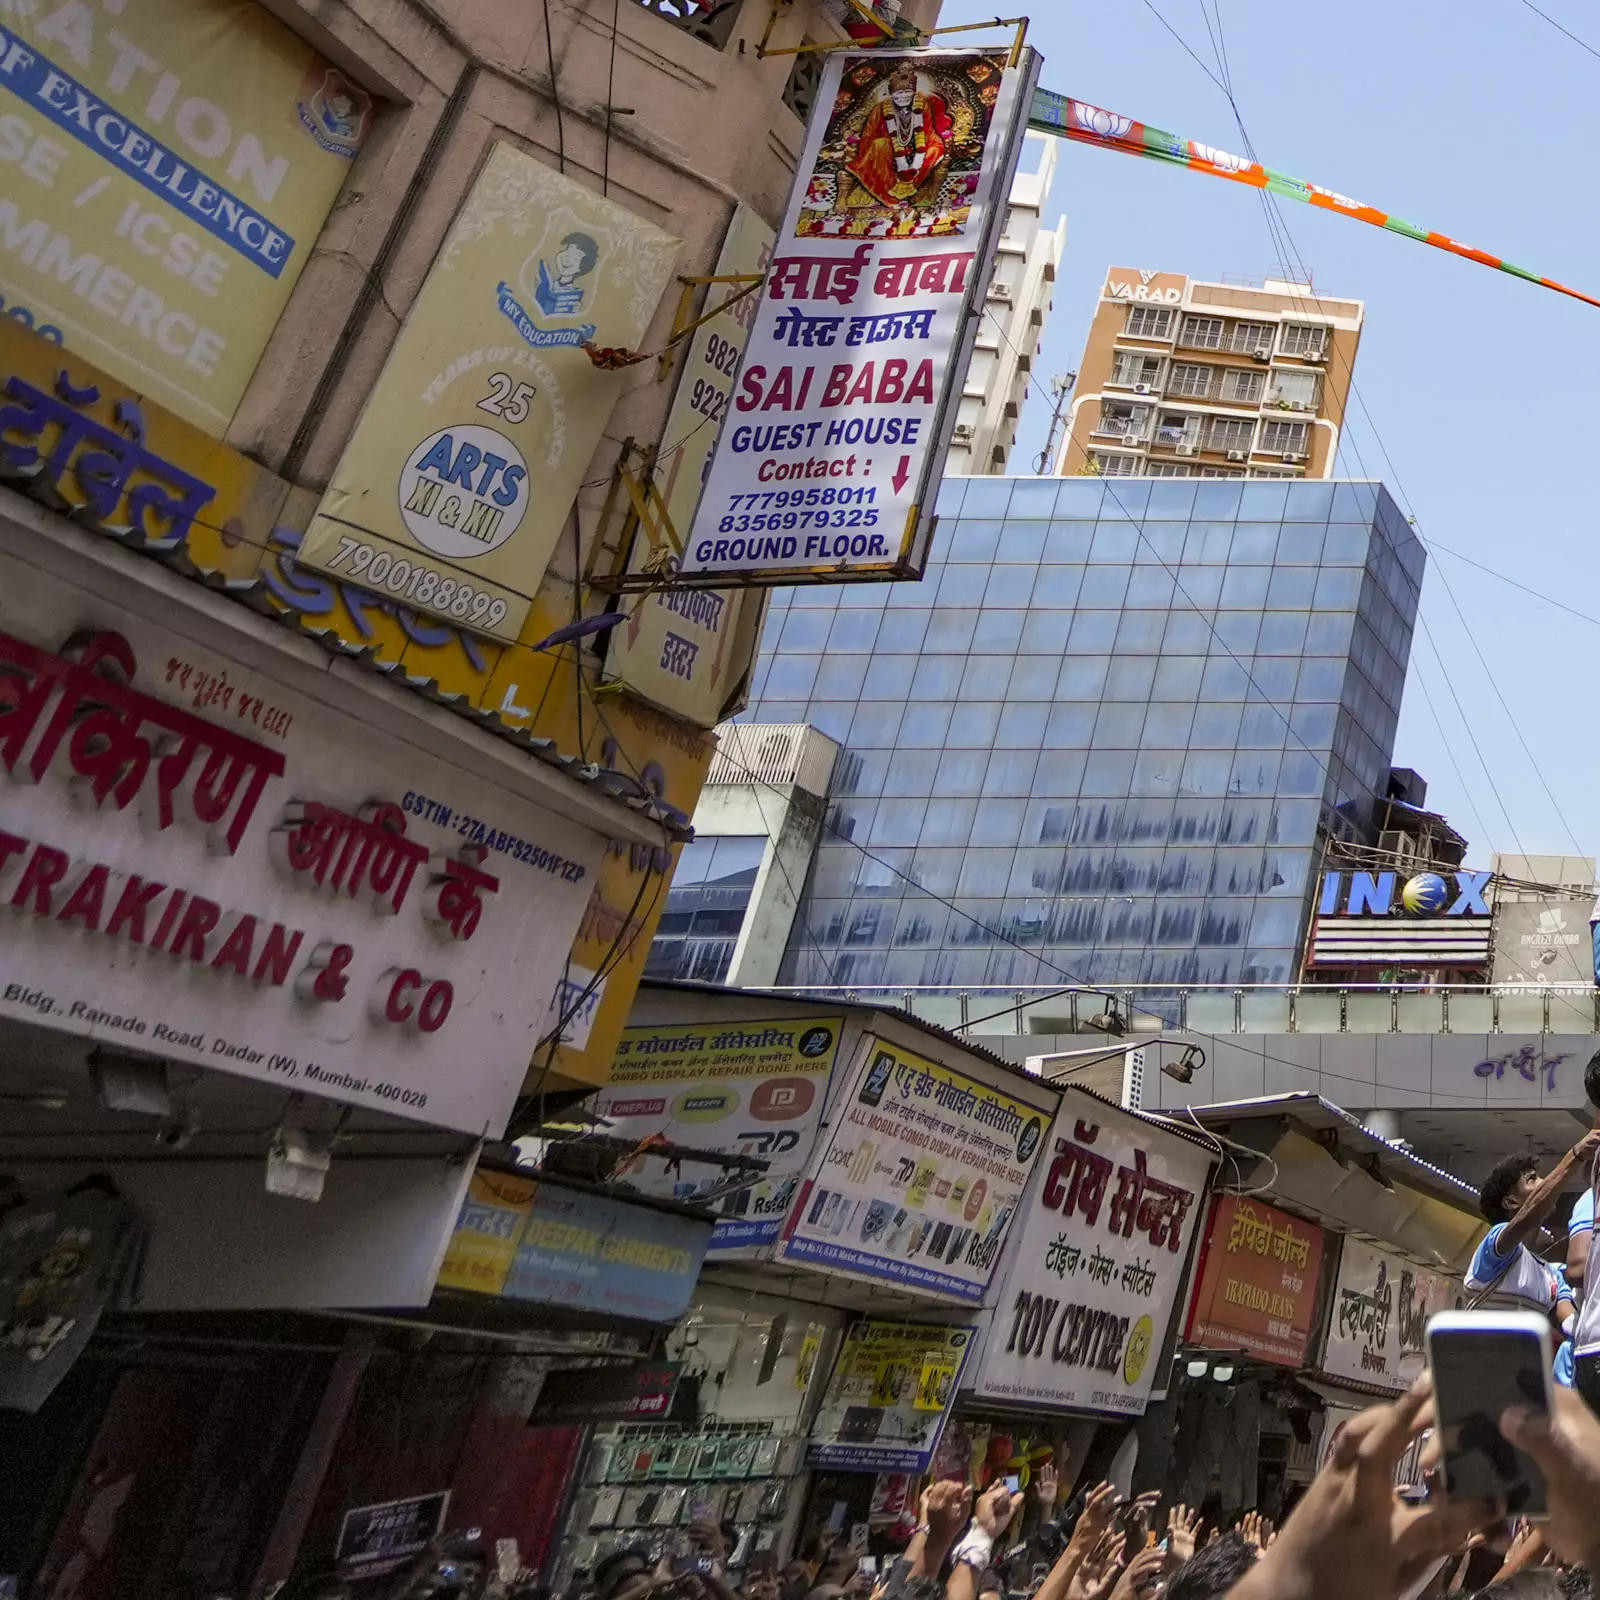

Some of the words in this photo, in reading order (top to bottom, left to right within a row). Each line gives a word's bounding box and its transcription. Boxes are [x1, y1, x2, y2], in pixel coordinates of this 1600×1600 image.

[36, 68, 288, 265] EXCELLENCE
[114, 199, 231, 298] ICSE
[768, 243, 875, 305] साई
[875, 251, 976, 300] बाबा
[1108, 281, 1182, 305] VARAD
[503, 299, 518, 321] MY
[517, 318, 580, 346] EDUCATION
[773, 306, 845, 348] गेस्ट
[845, 309, 937, 347] हाऊस
[419, 348, 484, 405] YEARS
[477, 372, 537, 424] 25
[736, 364, 815, 412] SAI
[819, 358, 934, 408] BABA
[731, 421, 822, 453] GUEST
[825, 417, 922, 447] HOUSE
[415, 433, 527, 507] ARTS
[758, 455, 857, 483] Contact
[404, 475, 444, 517] XI
[437, 495, 461, 528] &
[462, 498, 504, 545] XII
[718, 508, 879, 534] 8356979325
[728, 486, 877, 512] 7779958011
[695, 536, 798, 563] GROUND
[803, 534, 889, 559] FLOOR.
[326, 535, 509, 630] 7900188899
[401, 791, 453, 829] GSTIN
[1520, 934, 1551, 946] ANGREZI
[313, 944, 354, 1002] &
[386, 968, 454, 1033] CO
[69, 1000, 147, 1034] Ranade
[212, 1038, 264, 1064] Dadar
[610, 1070, 649, 1082] OMBO
[651, 1066, 708, 1081] DISPLAY
[708, 1064, 753, 1076] REPAIR
[757, 1063, 791, 1074] DONE
[794, 1061, 828, 1072] HERE
[614, 1101, 662, 1114] ONEPLUS
[848, 1107, 866, 1128] ALL
[868, 1112, 900, 1138] MOBILE
[900, 1124, 929, 1150] COMBO
[928, 1134, 961, 1163] DISPLAY
[961, 1147, 987, 1172] REPAIR
[986, 1157, 1006, 1178] DONE
[1006, 1165, 1025, 1187] HERE
[1042, 1119, 1114, 1228] टॉय
[1269, 1291, 1296, 1320] JEANS
[1005, 1290, 1060, 1360] TOY
[1054, 1302, 1130, 1376] CENTRE
